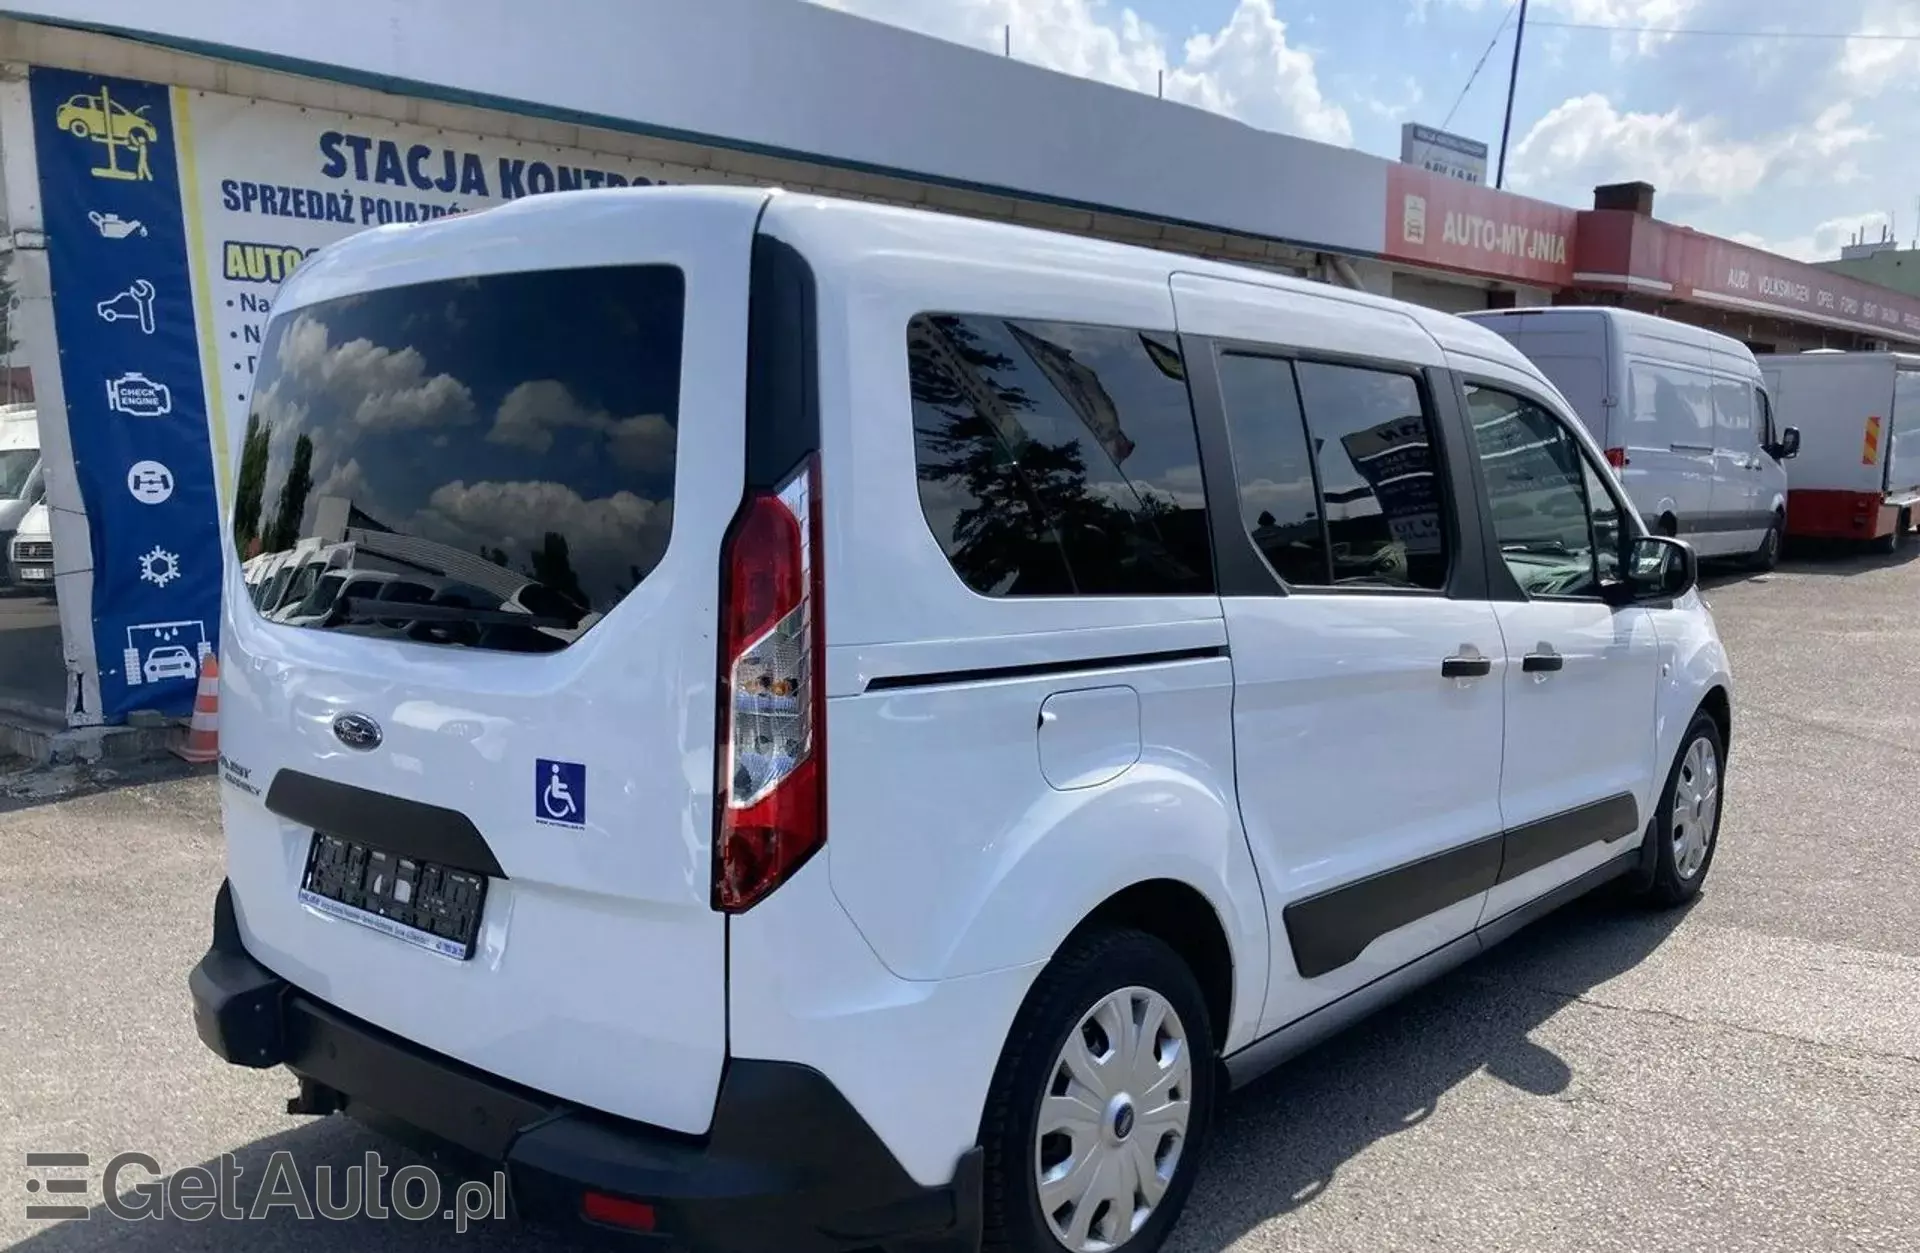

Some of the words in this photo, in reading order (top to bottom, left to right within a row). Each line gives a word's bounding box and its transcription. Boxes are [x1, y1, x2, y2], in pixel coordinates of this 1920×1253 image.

[319, 131, 489, 198] STACJA
[221, 178, 355, 225] SPRZEDAŻ
[1442, 209, 1566, 265] AUTO-MYJNIA
[120, 388, 156, 396] CHECK
[122, 397, 159, 405] ENGINE
